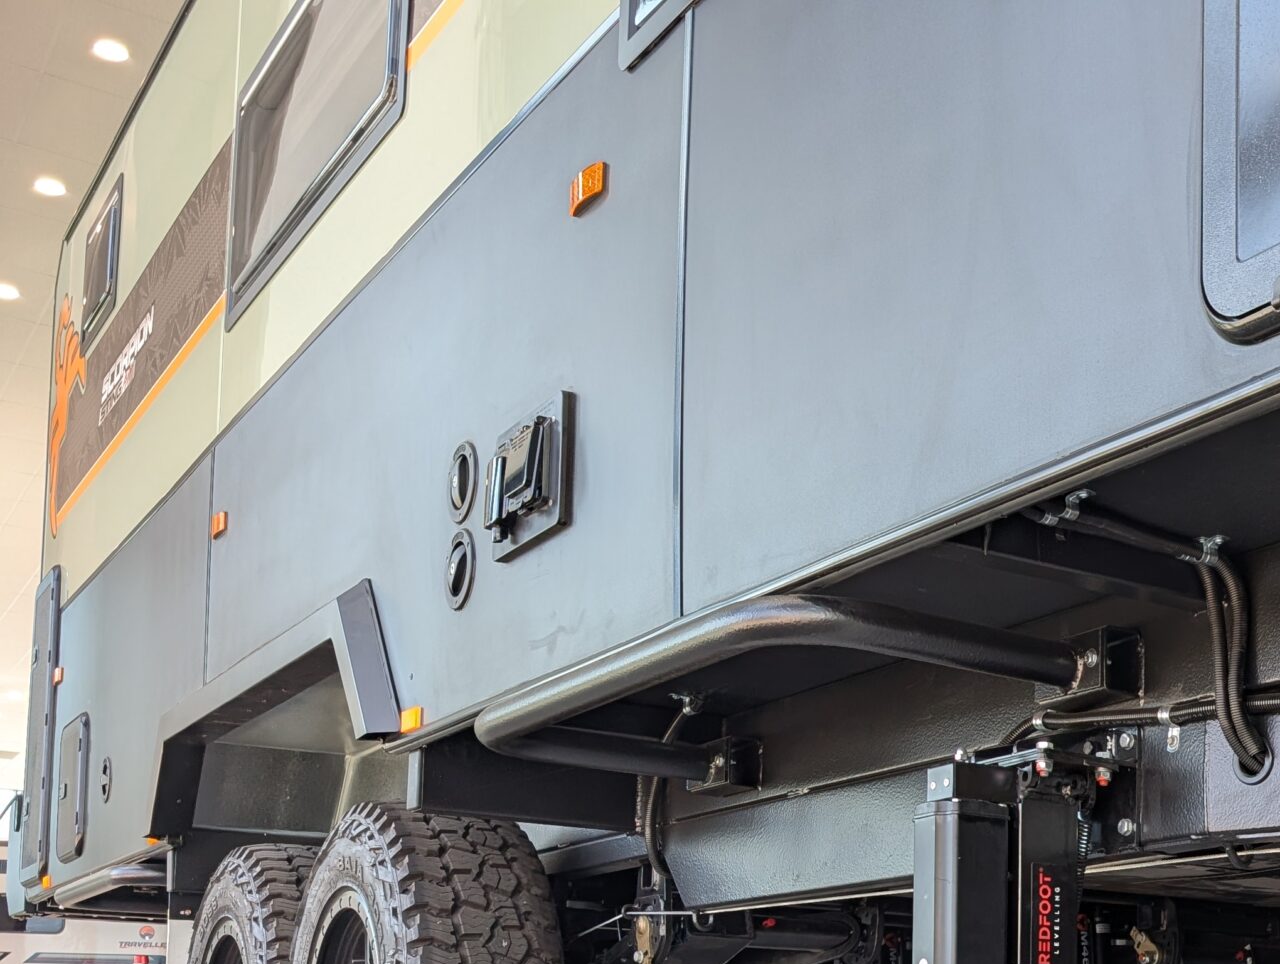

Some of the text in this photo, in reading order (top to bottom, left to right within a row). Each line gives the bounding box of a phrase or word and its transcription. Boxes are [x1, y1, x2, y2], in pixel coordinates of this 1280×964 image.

[101, 304, 155, 404] SCORPION
[337, 855, 365, 884] BAJA
[1053, 886, 1061, 955] LEVELLING
